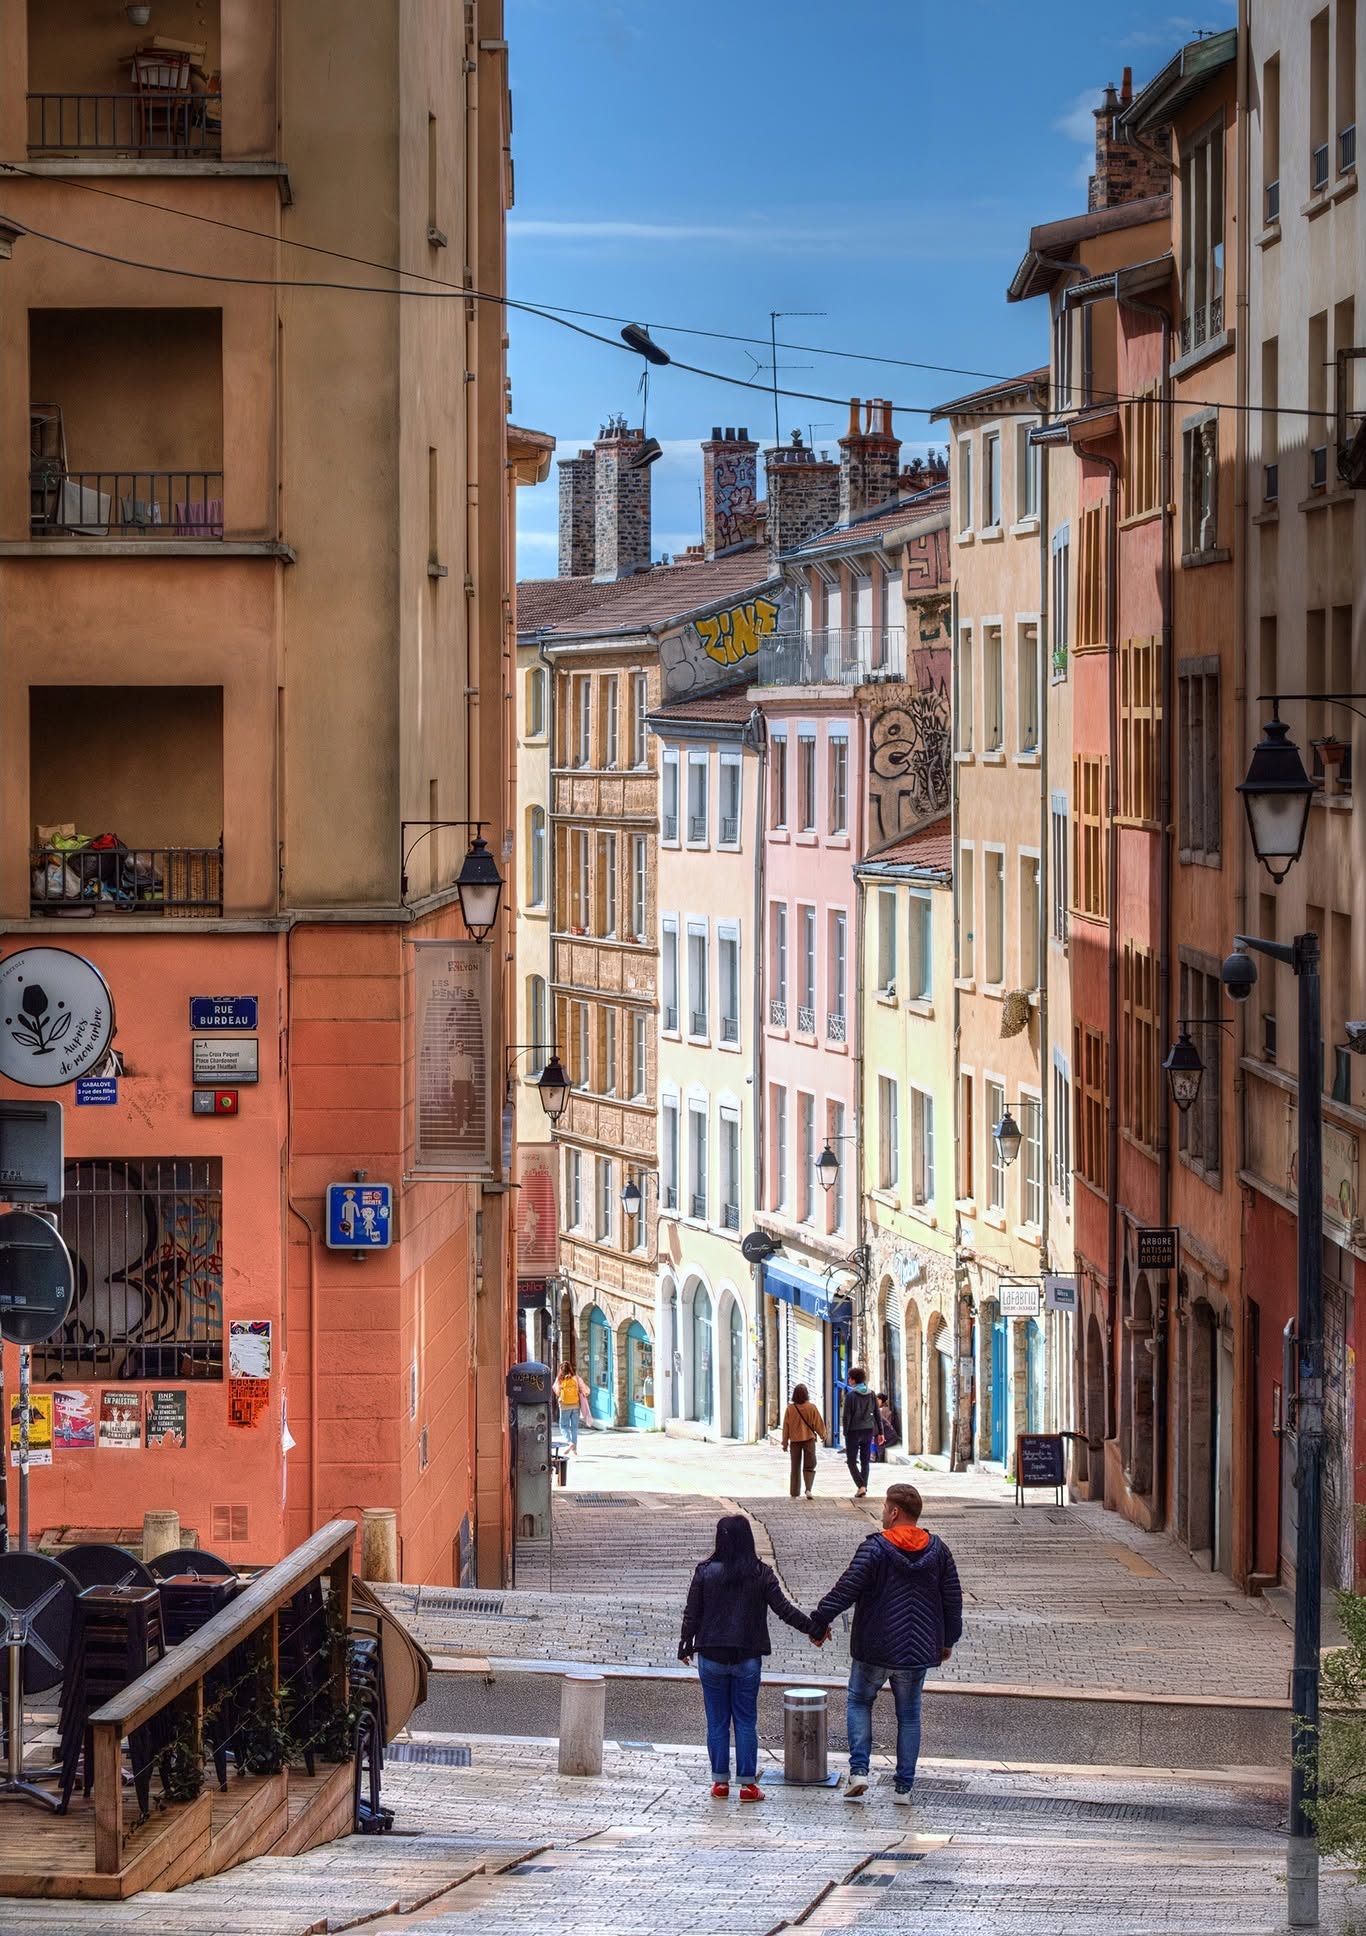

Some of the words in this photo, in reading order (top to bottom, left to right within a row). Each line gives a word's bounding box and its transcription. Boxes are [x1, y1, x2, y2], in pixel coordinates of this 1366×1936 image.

[432, 986, 474, 1000] PENTES
[214, 1005, 234, 1014] RUE
[200, 1016, 248, 1025] BURDEAU
[60, 1061, 73, 1075] de
[73, 1042, 94, 1066] mon
[90, 1006, 102, 1042] arbre
[64, 1018, 88, 1056] Auprès
[1141, 1237, 1172, 1246] ARBORE
[1141, 1246, 1172, 1254] ARTISAN
[1141, 1255, 1172, 1264] DOREUR
[112, 1396, 139, 1405] PALESTINE
